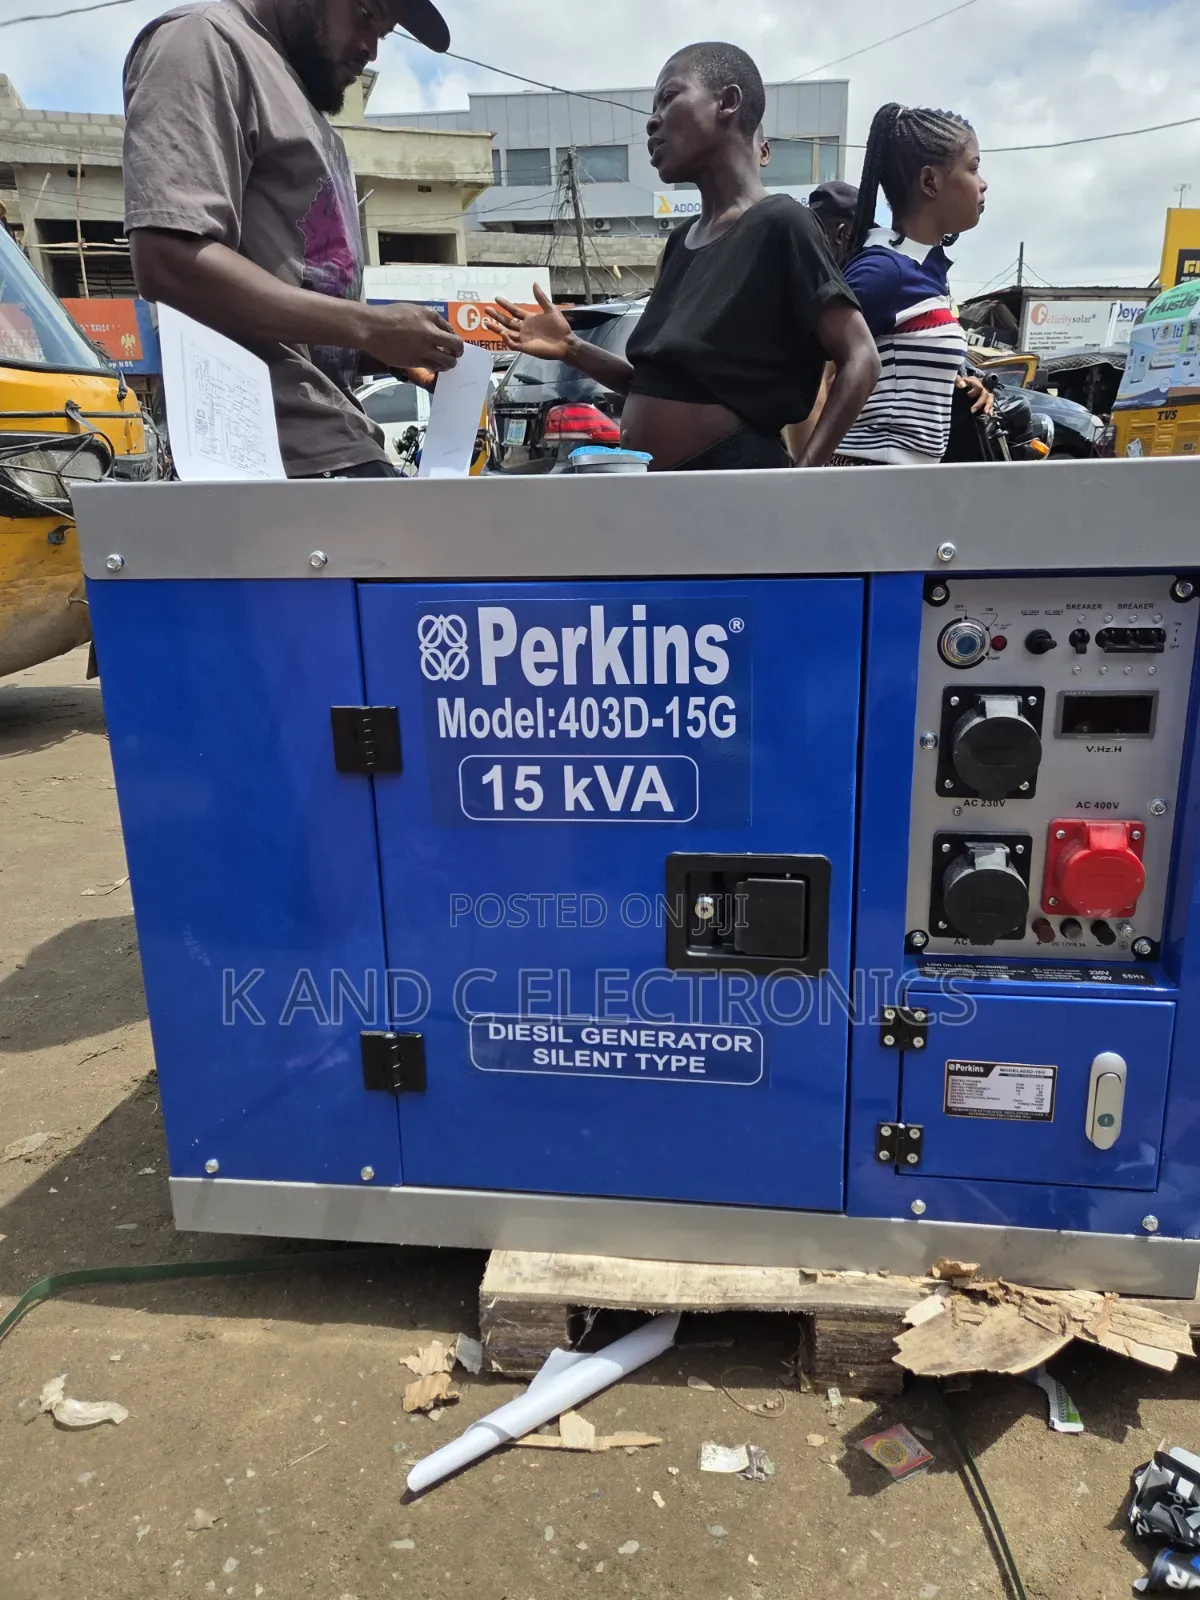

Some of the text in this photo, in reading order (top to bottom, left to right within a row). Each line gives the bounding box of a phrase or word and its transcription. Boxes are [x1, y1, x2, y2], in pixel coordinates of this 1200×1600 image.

[674, 203, 701, 213] ADDO
[1157, 409, 1178, 421] TVS
[437, 696, 736, 738] Model:403D-15G
[1086, 745, 1122, 753] V.Hz.H
[482, 765, 675, 812] 15 kVA
[963, 799, 1006, 808] AC 230V
[1076, 801, 1120, 810] AC 400V
[953, 938, 968, 946] AC
[489, 1023, 753, 1053] DIESIL GENERATOR
[533, 1048, 706, 1073] SILENT TYPE
[955, 1063, 984, 1073] Perkins
